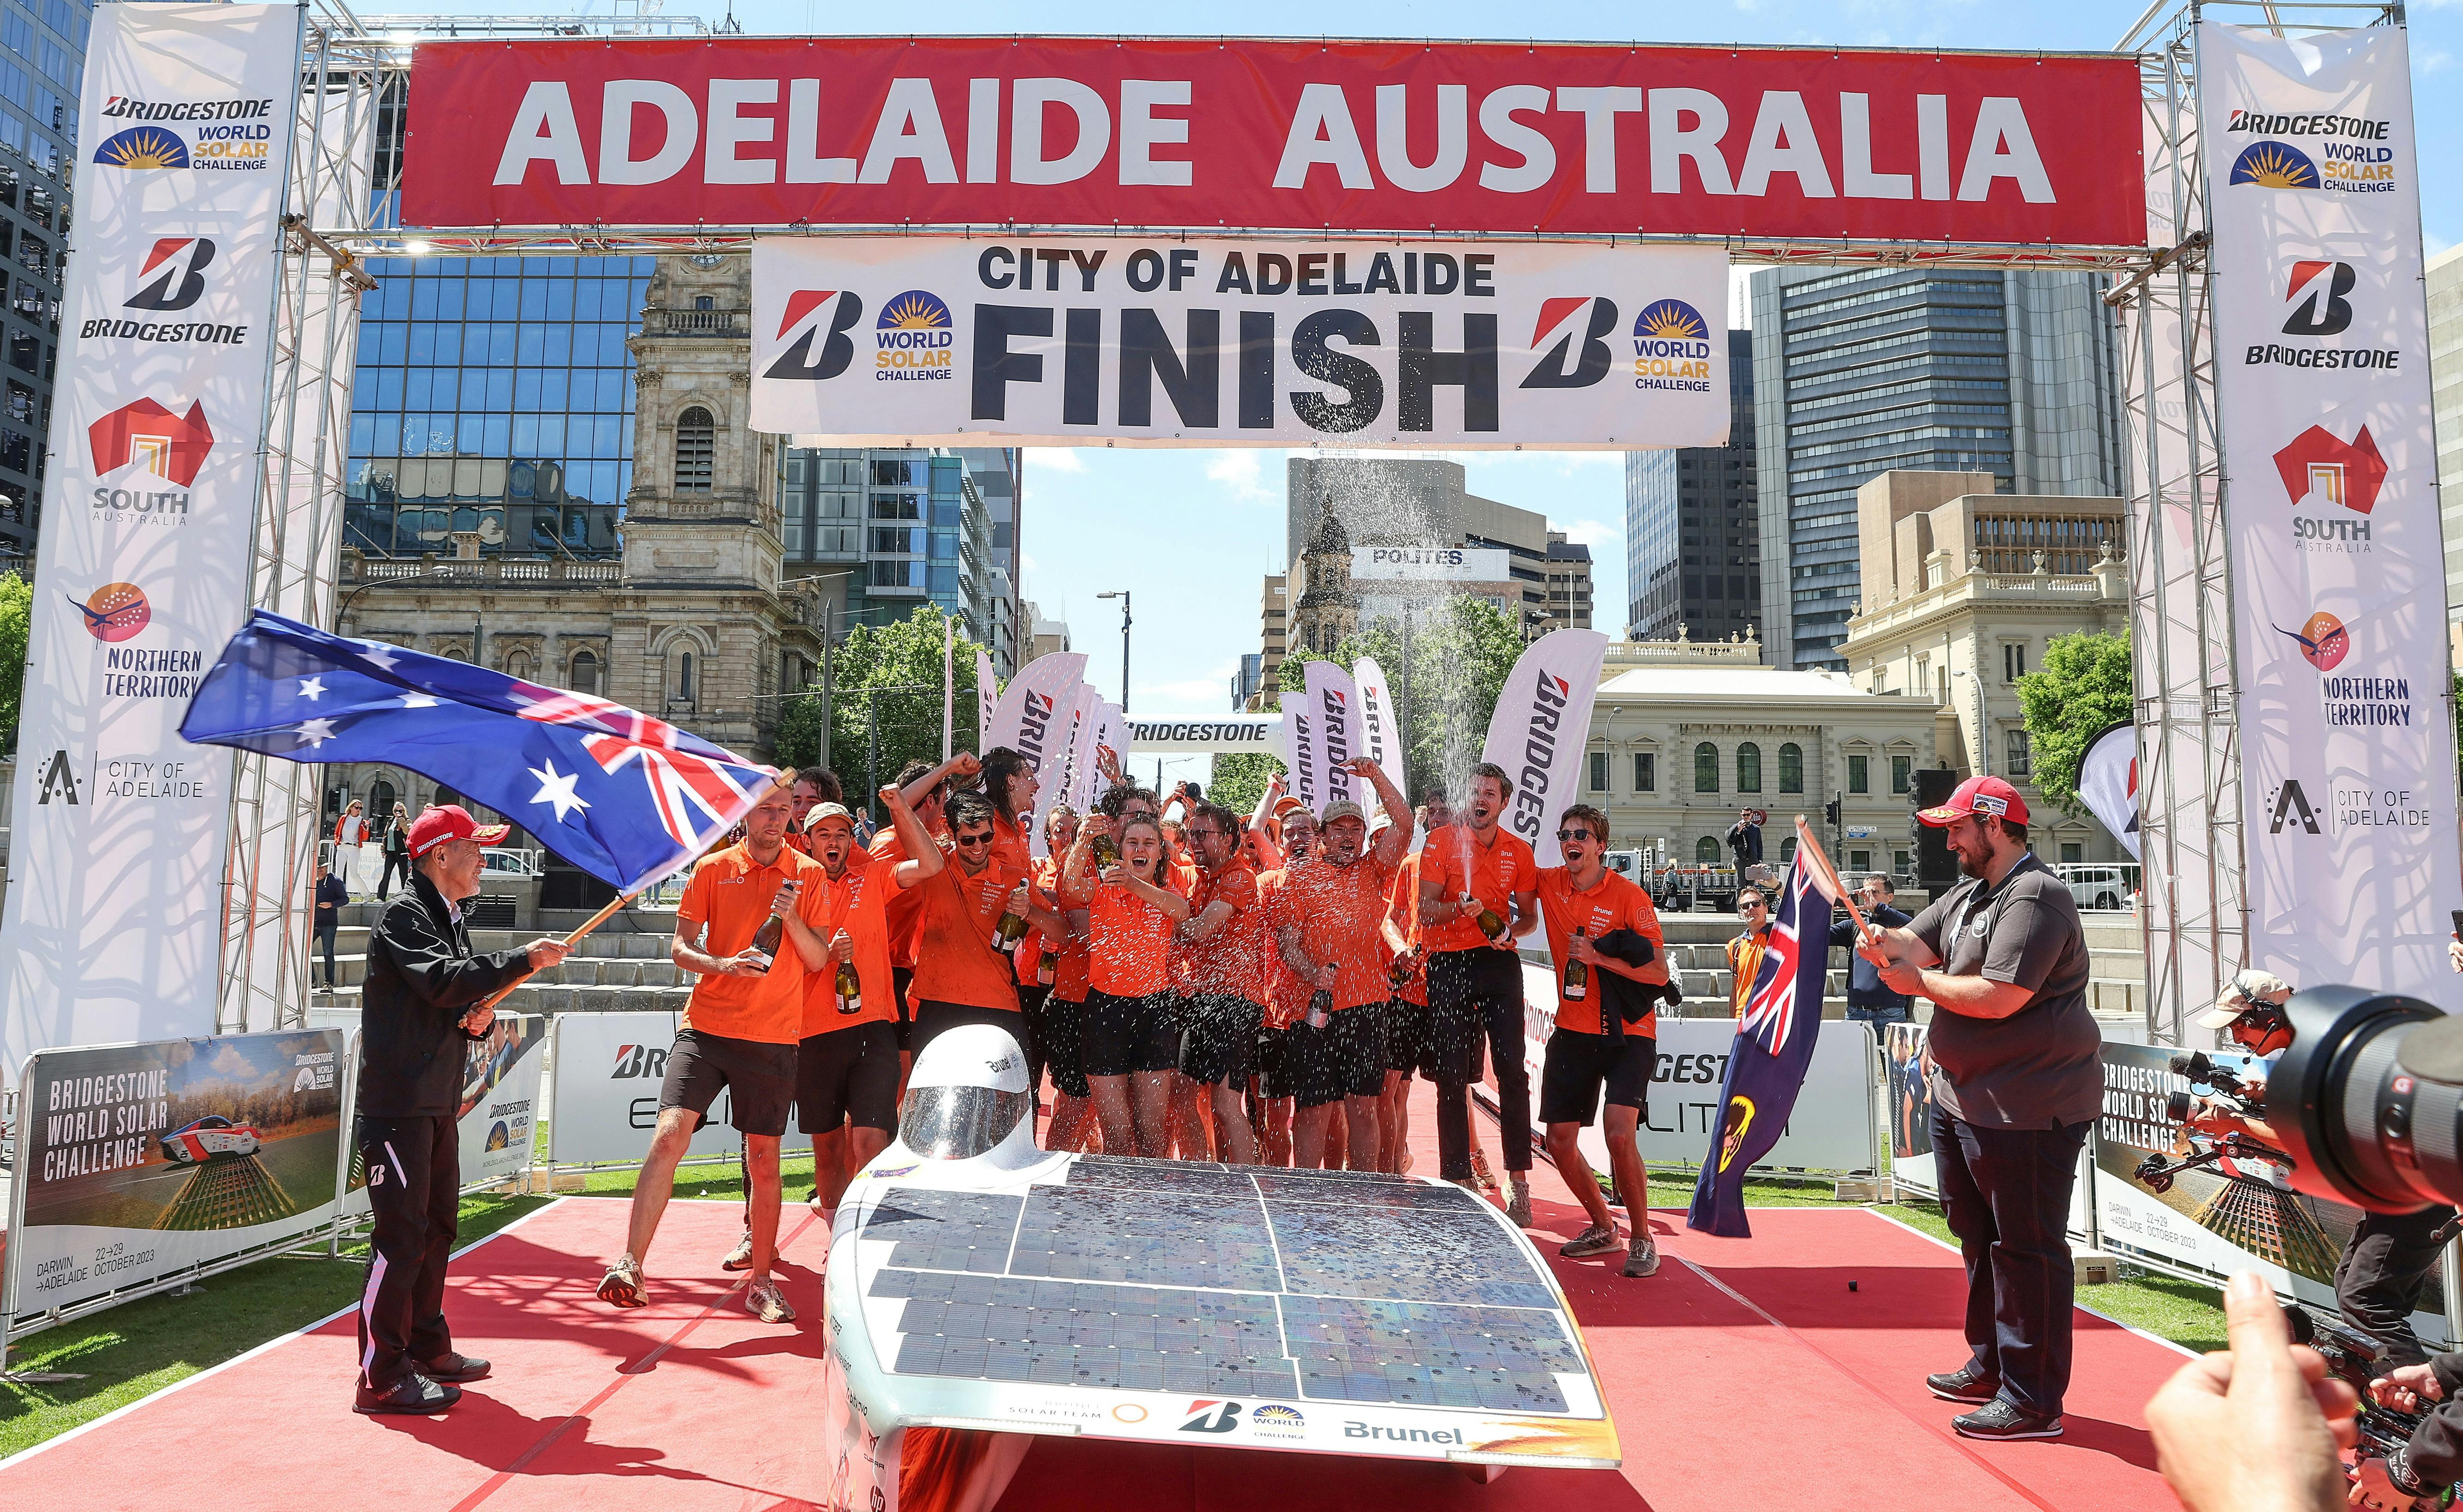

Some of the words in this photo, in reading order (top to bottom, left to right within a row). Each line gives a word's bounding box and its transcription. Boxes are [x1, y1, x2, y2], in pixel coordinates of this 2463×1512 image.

[101, 96, 273, 120] BRIDGESTONE
[198, 125, 270, 141] WORLD
[2227, 109, 2390, 140] BRIDGESTONE
[493, 77, 1192, 186] ADELAIDE
[1273, 82, 2056, 204] AUSTRALIA
[193, 143, 268, 158] SOLAR
[2324, 143, 2392, 162] WORLD
[193, 159, 267, 170] CHALLENGE
[2323, 161, 2394, 180] SOLAR
[2324, 180, 2395, 192] CHALLENGE
[978, 246, 1108, 292] CITY
[1126, 249, 1198, 292] OF
[1216, 250, 1495, 296] ADELAIDE
[80, 319, 248, 344] BRIDGESTONE
[877, 331, 953, 348] WORLD
[876, 349, 952, 368] SOLAR
[1634, 339, 1710, 359] WORLD
[2245, 344, 2399, 369] BRIDGESTONE
[876, 369, 951, 381] CHALLENGE
[971, 303, 1499, 432] FINISH
[1634, 358, 1709, 379] SOLAR
[1635, 378, 1710, 392] CHALLENGE
[93, 488, 189, 514] SOUTH
[93, 512, 187, 526] AUSTRALIA
[2294, 516, 2371, 541] SOUTH
[2296, 539, 2371, 553] AUSTRALIA
[1373, 548, 1463, 565] POLITES
[108, 649, 202, 672] NORTHERN
[105, 674, 199, 697] TERRITORY
[2324, 677, 2409, 700] NORTHERN
[2325, 702, 2411, 726] TERRITORY
[109, 762, 155, 778] CITY
[164, 763, 184, 778] OF
[107, 781, 203, 798] ADELAIDE
[2339, 790, 2374, 807] CITY
[2385, 791, 2410, 806] OF
[1976, 796, 2006, 806] BRIDGESTONE
[2340, 809, 2429, 826] ADELAIDE
[417, 832, 453, 853] BRIDGESTONE
[1593, 905, 1613, 916] Brunel
[296, 1052, 334, 1066] BRIDGESTONE
[985, 1054, 1012, 1073] Brunel
[316, 1066, 334, 1075] WORLD
[316, 1074, 333, 1083] SOLAR
[49, 1069, 167, 1111] BRIDGESTONE
[316, 1082, 333, 1090] CHALLENGE
[489, 1099, 531, 1119] BRIDGESTONE
[48, 1108, 109, 1147] WORLD
[116, 1101, 167, 1137] SOLAR
[511, 1116, 529, 1128] WORLD
[509, 1126, 527, 1139] SOLAR
[2102, 1116, 2178, 1155] CHALLENGE
[509, 1138, 526, 1148] CHALLENGE
[44, 1136, 146, 1182] CHALLENGE
[2109, 1202, 2131, 1217] DARWIN
[2115, 1216, 2143, 1233] ADELAIDE
[2147, 1226, 2179, 1244] OCTOBER
[2180, 1235, 2196, 1250] 2023
[37, 1255, 73, 1278] DARWIN
[95, 1255, 135, 1277] OCTOBER
[137, 1249, 155, 1266] 2023
[45, 1267, 88, 1291] ADELAIDE
[850, 1393, 868, 1416] bitvavo
[1009, 1407, 1057, 1416] SOLAR
[1064, 1411, 1101, 1419] TEAM
[1253, 1417, 1305, 1428] WORLD
[1254, 1432, 1306, 1440] CHALLENGE
[1344, 1421, 1463, 1445] Brunel
[864, 1453, 885, 1470] CUPRA
[871, 1485, 883, 1512] hp
